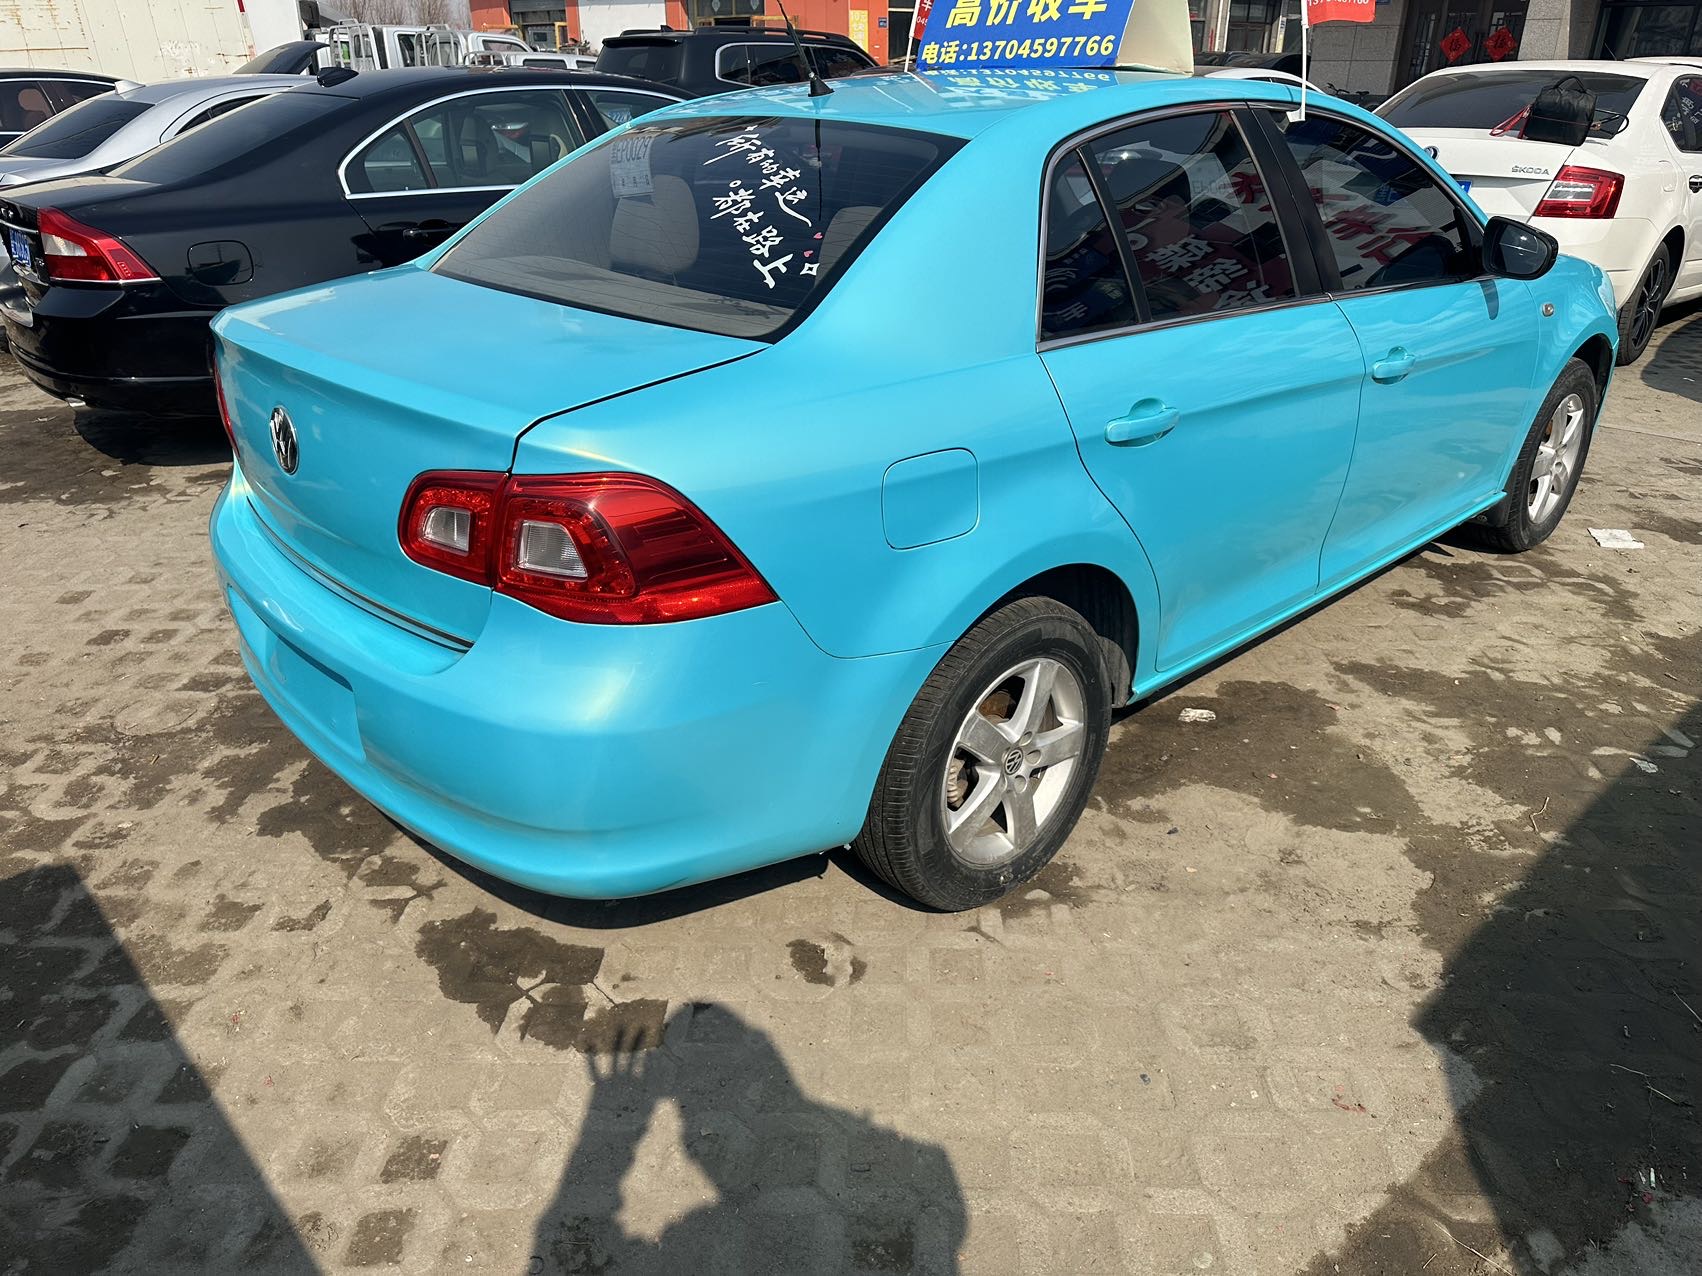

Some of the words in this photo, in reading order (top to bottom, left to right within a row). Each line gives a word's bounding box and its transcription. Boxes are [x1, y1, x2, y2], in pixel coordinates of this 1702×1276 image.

[921, 35, 1116, 64] 电话:13704597766
[710, 188, 793, 289] 都在路上
